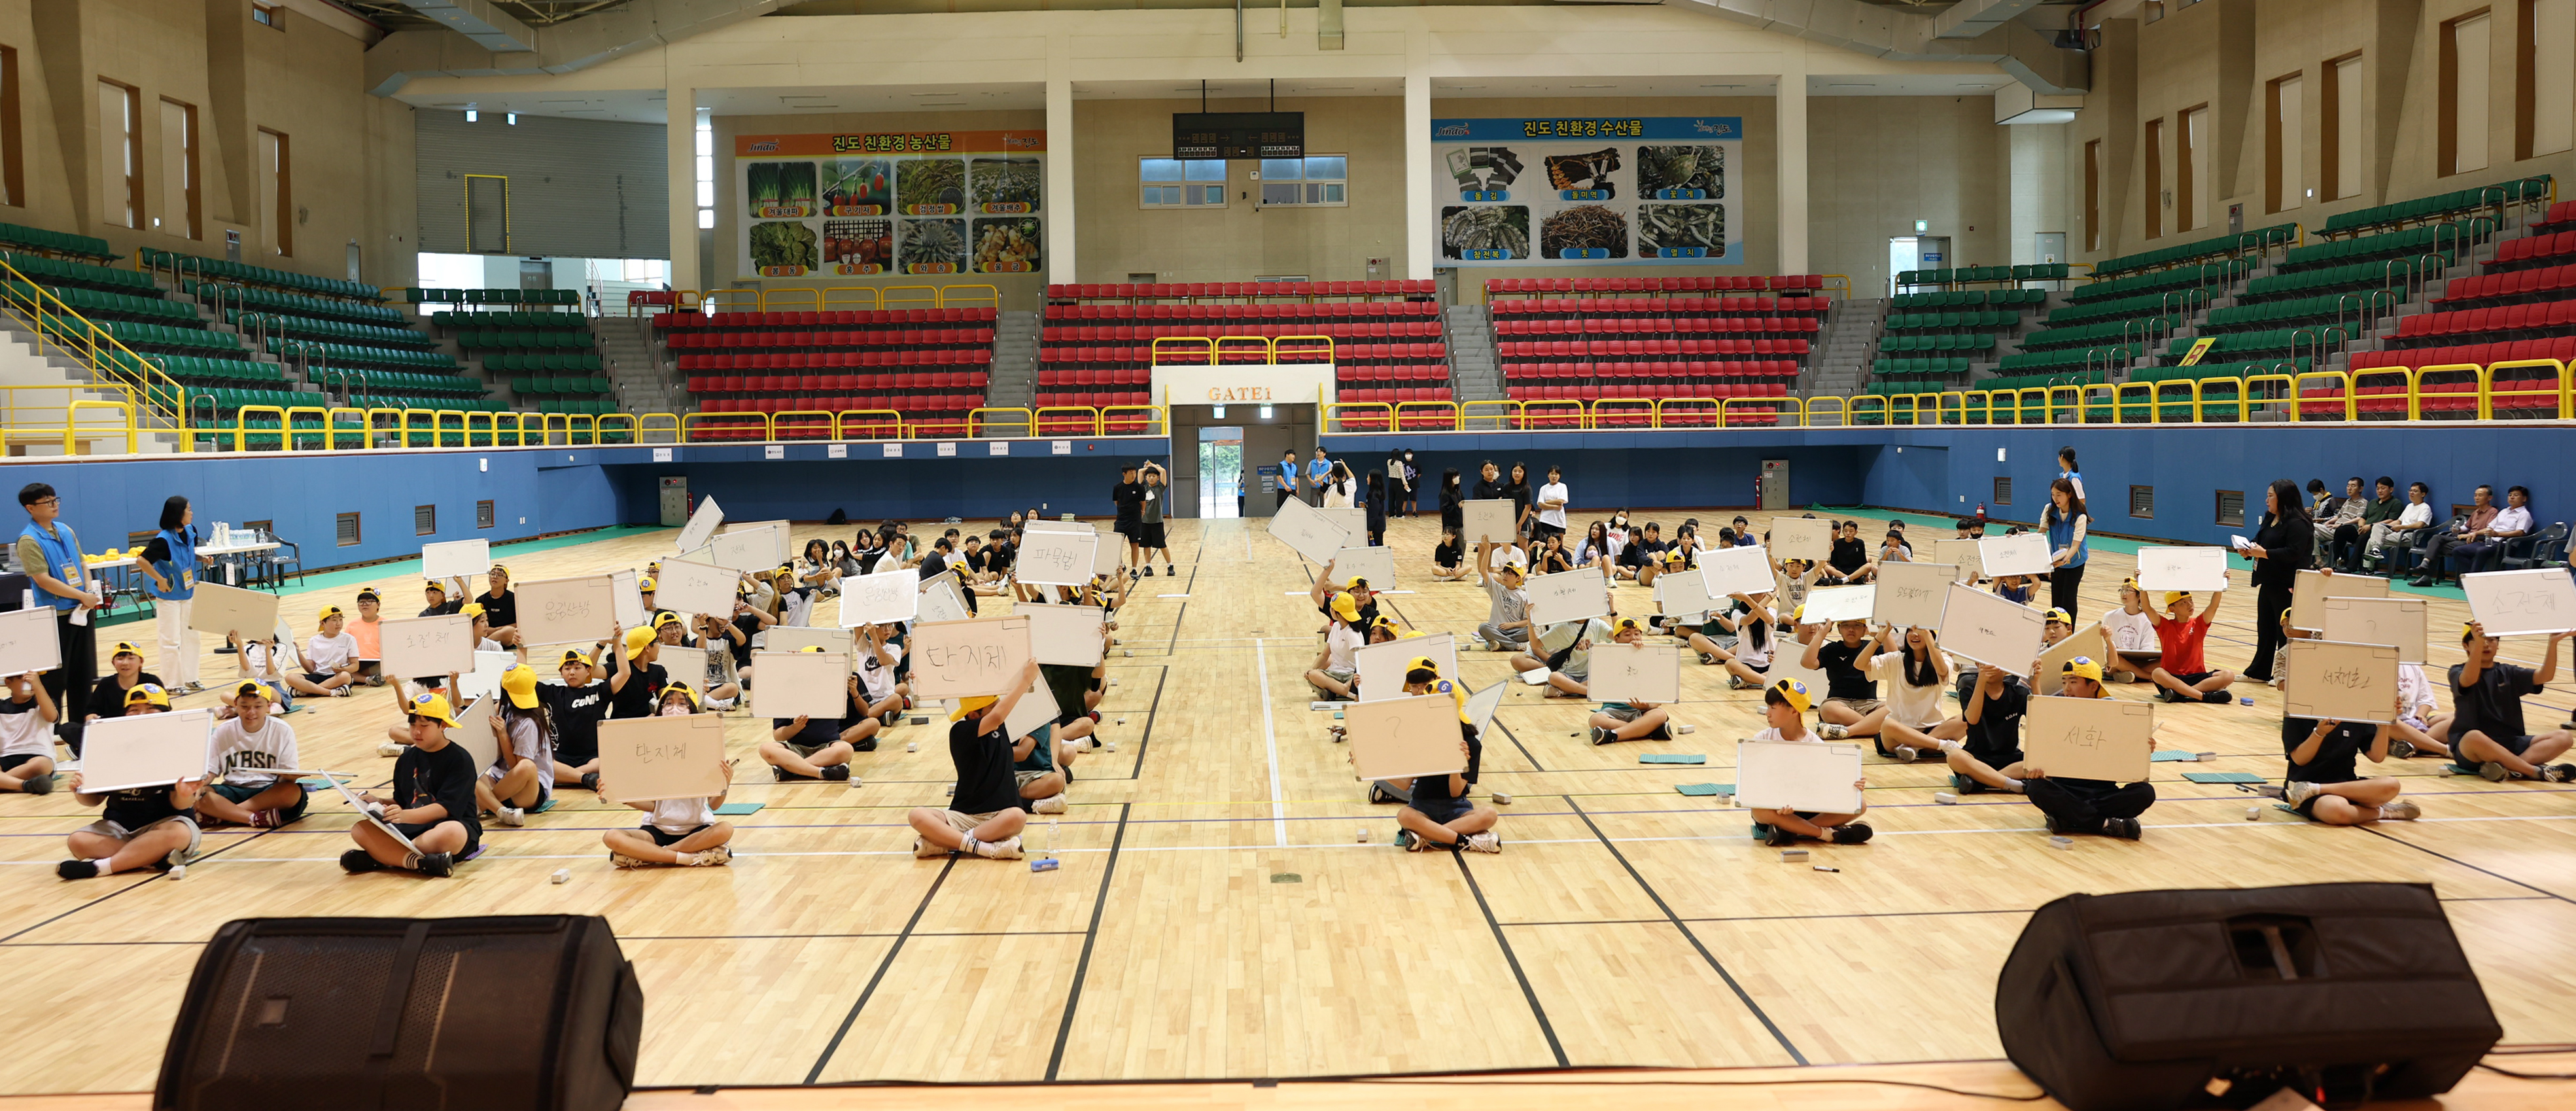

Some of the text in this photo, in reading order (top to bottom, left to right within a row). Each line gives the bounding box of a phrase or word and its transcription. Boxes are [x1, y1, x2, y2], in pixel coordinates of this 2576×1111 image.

[1435, 127, 1465, 136] Jindo
[1523, 120, 1643, 137] 진도 친환경 수산물
[1713, 124, 1732, 135] 진도
[748, 143, 776, 152] Jindo
[833, 134, 951, 152] 진도 친환경 농산물
[1022, 137, 1040, 148] 진도
[1571, 190, 1597, 200] 돌미역
[769, 208, 799, 217] 겨울대파
[845, 206, 871, 215] 구기자
[920, 204, 945, 213] 검정쌀
[991, 203, 1022, 213] 겨울배추
[1474, 250, 1499, 259] 참전복
[1208, 386, 1272, 401] GATE1
[1788, 534, 1811, 543] 소전체
[2492, 590, 2555, 615] 소전체
[546, 600, 591, 622] 운림산방
[1441, 682, 1449, 691] 6
[2064, 725, 2106, 750] 서화
